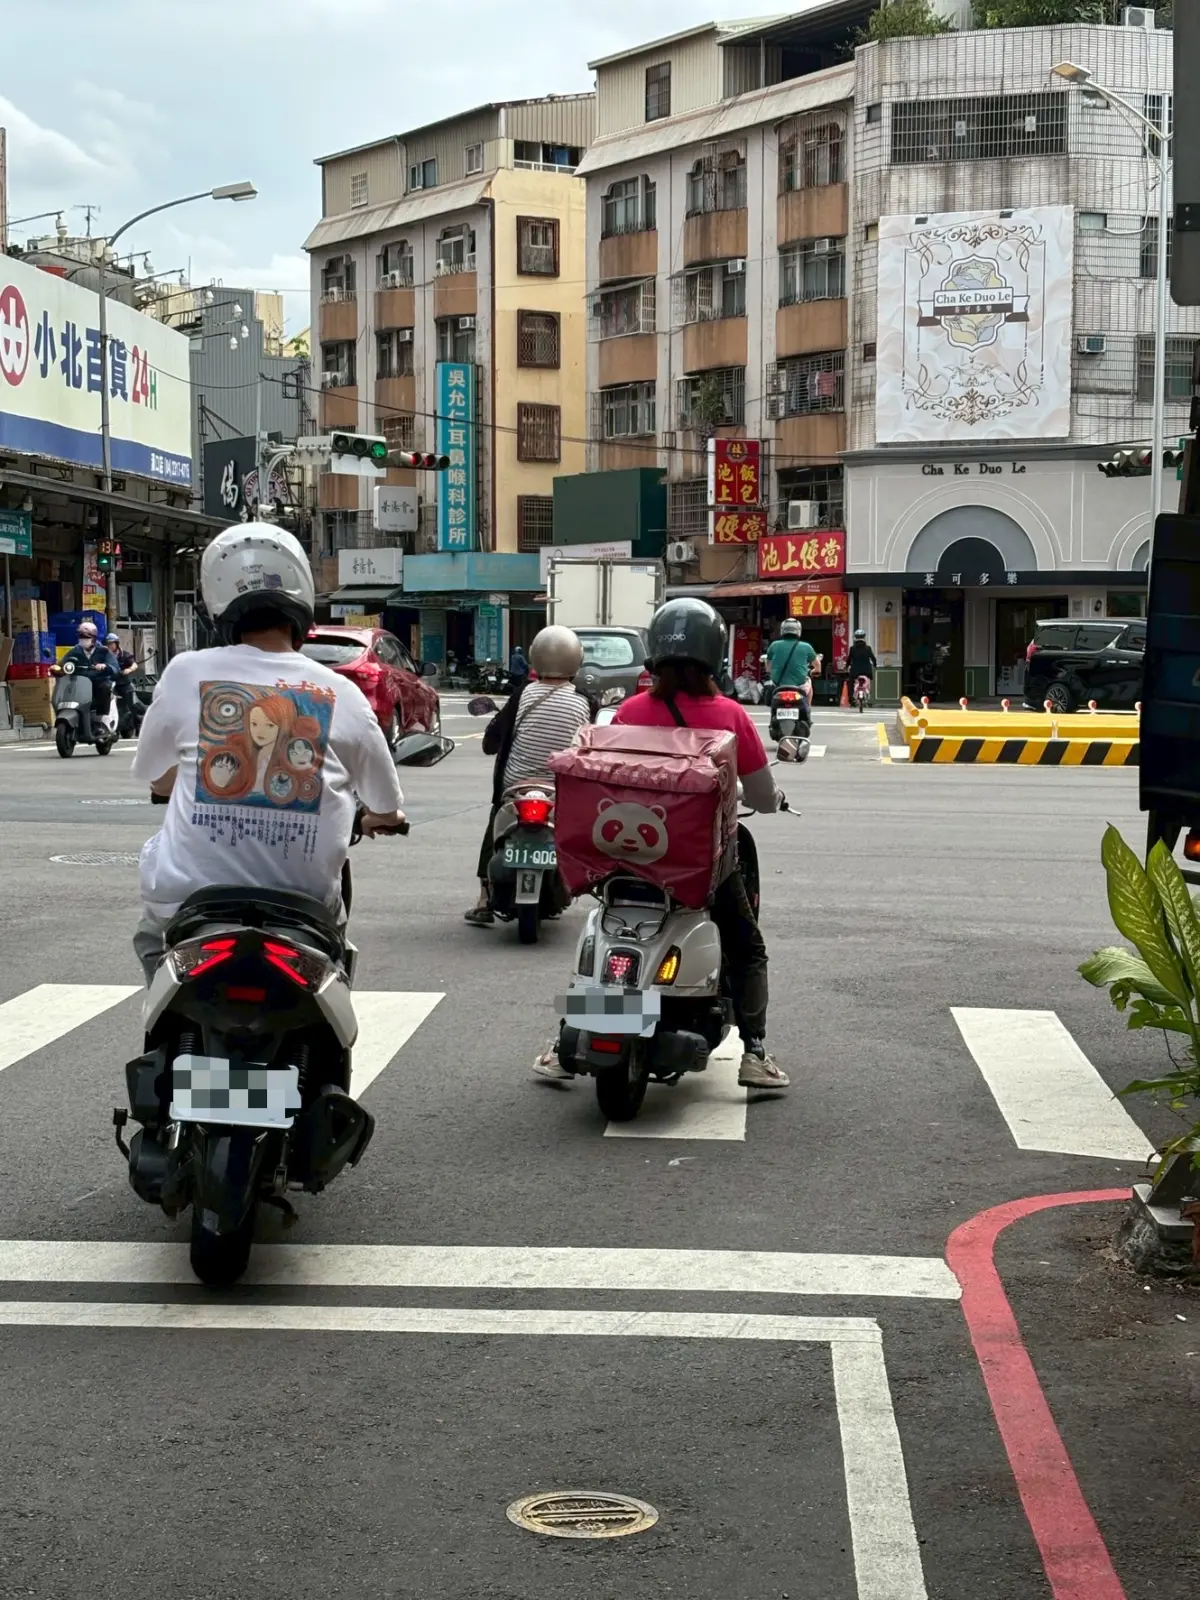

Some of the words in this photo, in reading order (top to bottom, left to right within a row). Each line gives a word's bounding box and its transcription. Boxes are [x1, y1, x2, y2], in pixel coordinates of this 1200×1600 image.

[936, 294, 956, 304] Cha
[959, 292, 972, 303] Ke
[974, 292, 996, 302] Duo
[998, 291, 1011, 301] Le
[34, 310, 128, 402] 小北百貨
[921, 464, 944, 475] Cha
[953, 463, 970, 475] Ke
[978, 462, 1002, 474] Duo
[1011, 462, 1026, 473] Le
[718, 463, 734, 502] 池上
[740, 463, 757, 503] 飯包
[716, 514, 763, 541] 便當
[761, 537, 841, 572] 池上便當
[924, 572, 1018, 585] 茶可多樂
[804, 594, 833, 615] 70
